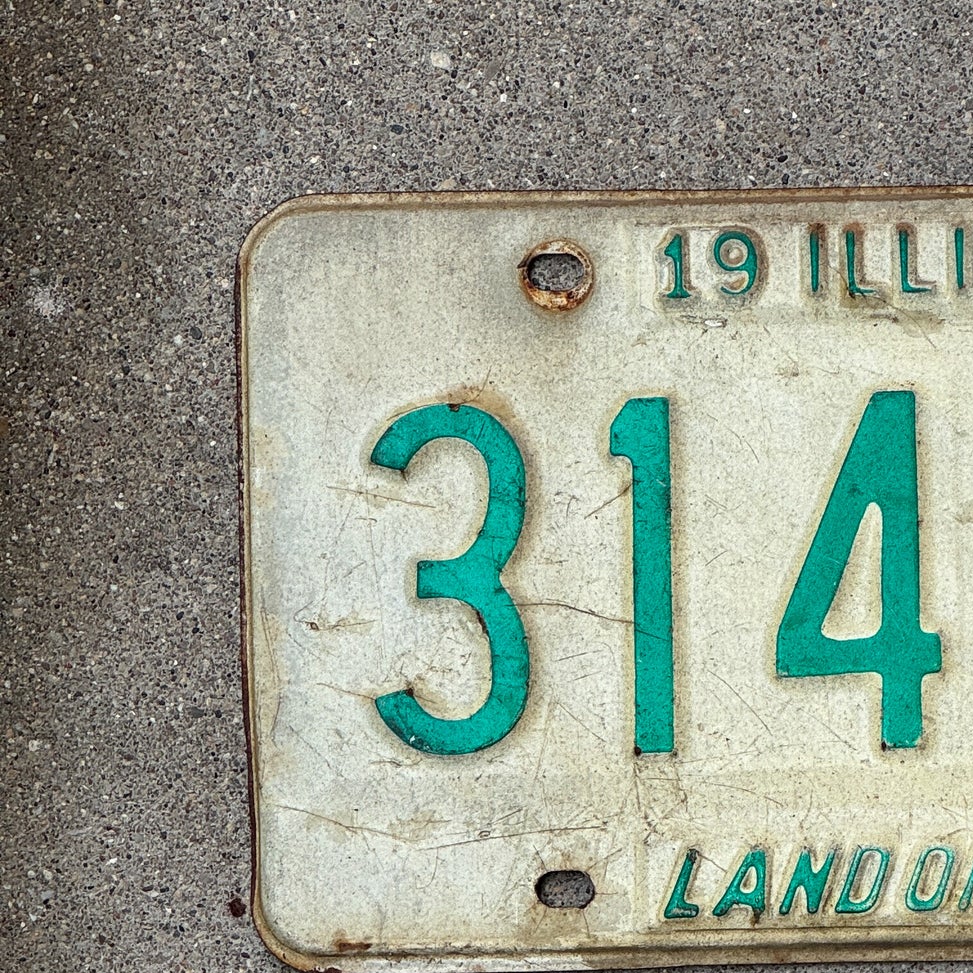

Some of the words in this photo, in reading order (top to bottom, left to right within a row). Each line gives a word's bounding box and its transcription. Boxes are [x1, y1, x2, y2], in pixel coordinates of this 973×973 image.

[662, 229, 759, 300] 19
[370, 390, 943, 757] 314
[663, 846, 893, 919] LAND
